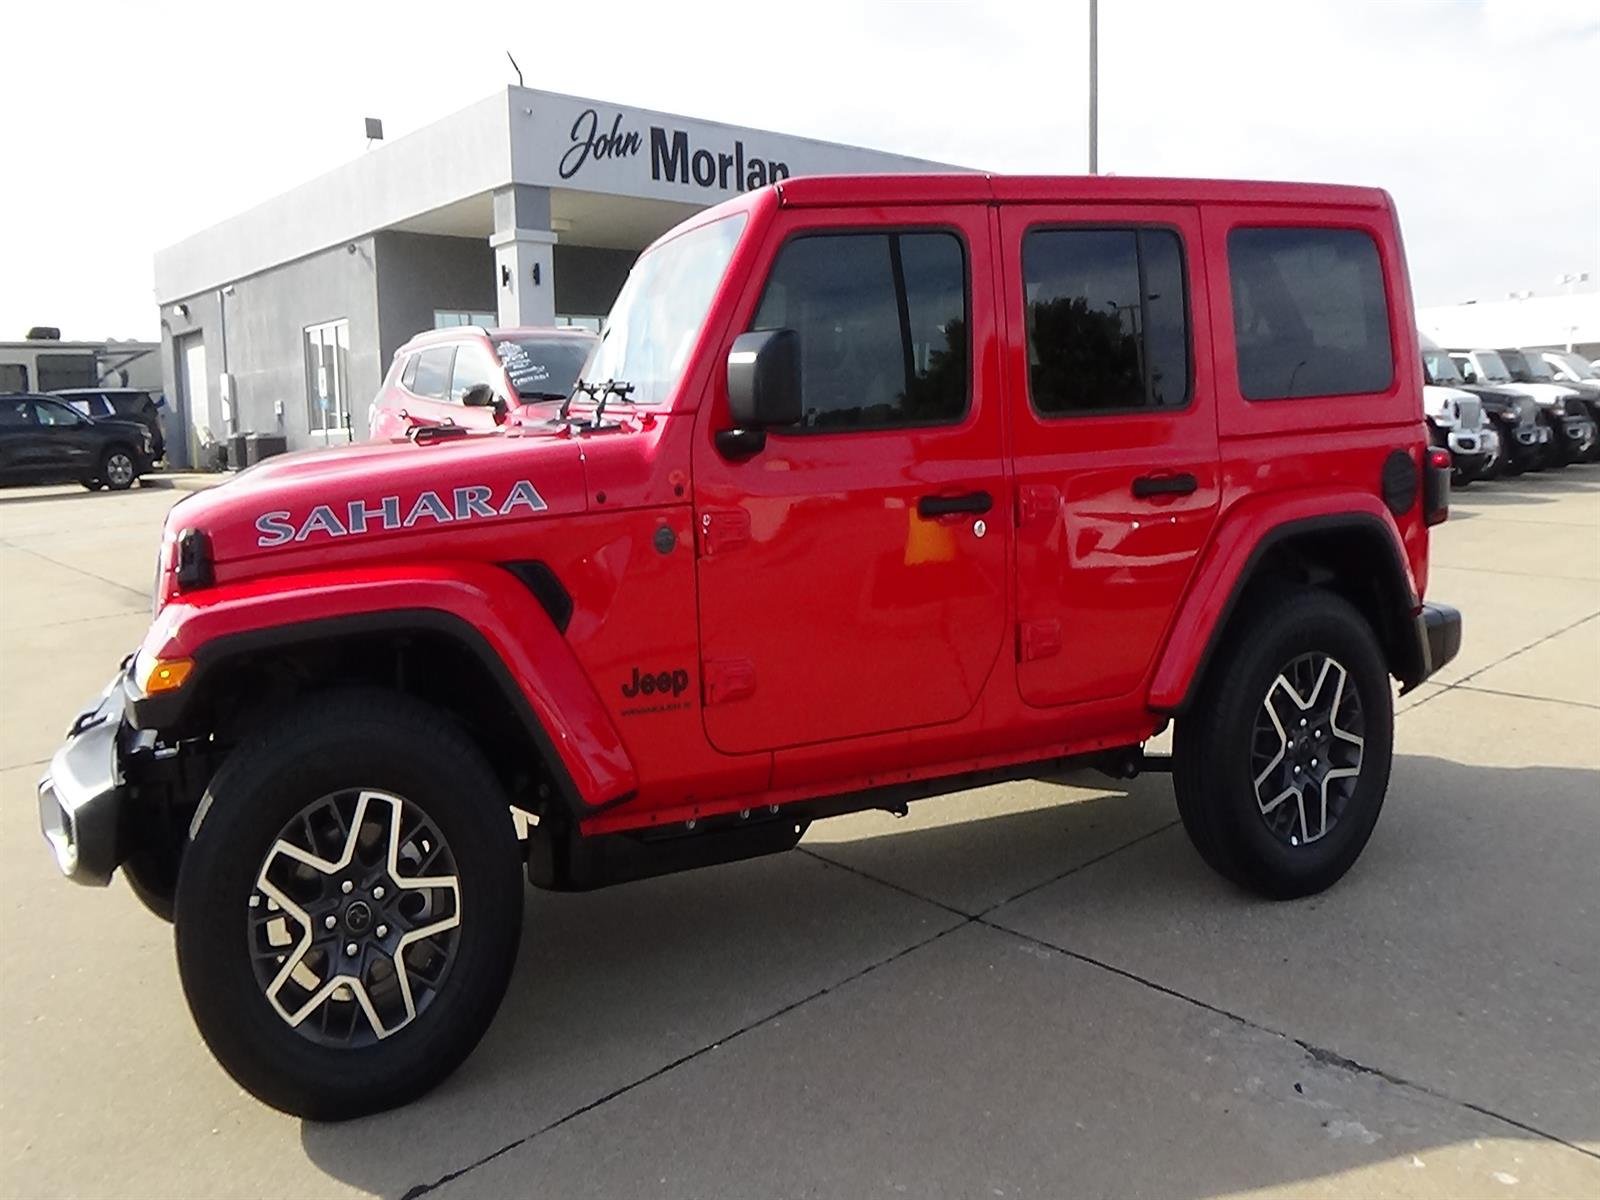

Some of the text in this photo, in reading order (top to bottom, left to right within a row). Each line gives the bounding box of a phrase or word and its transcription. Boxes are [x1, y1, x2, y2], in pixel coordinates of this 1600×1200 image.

[559, 108, 790, 192] John Morlan
[255, 480, 548, 547] SAHARA
[622, 667, 689, 698] Jeep
